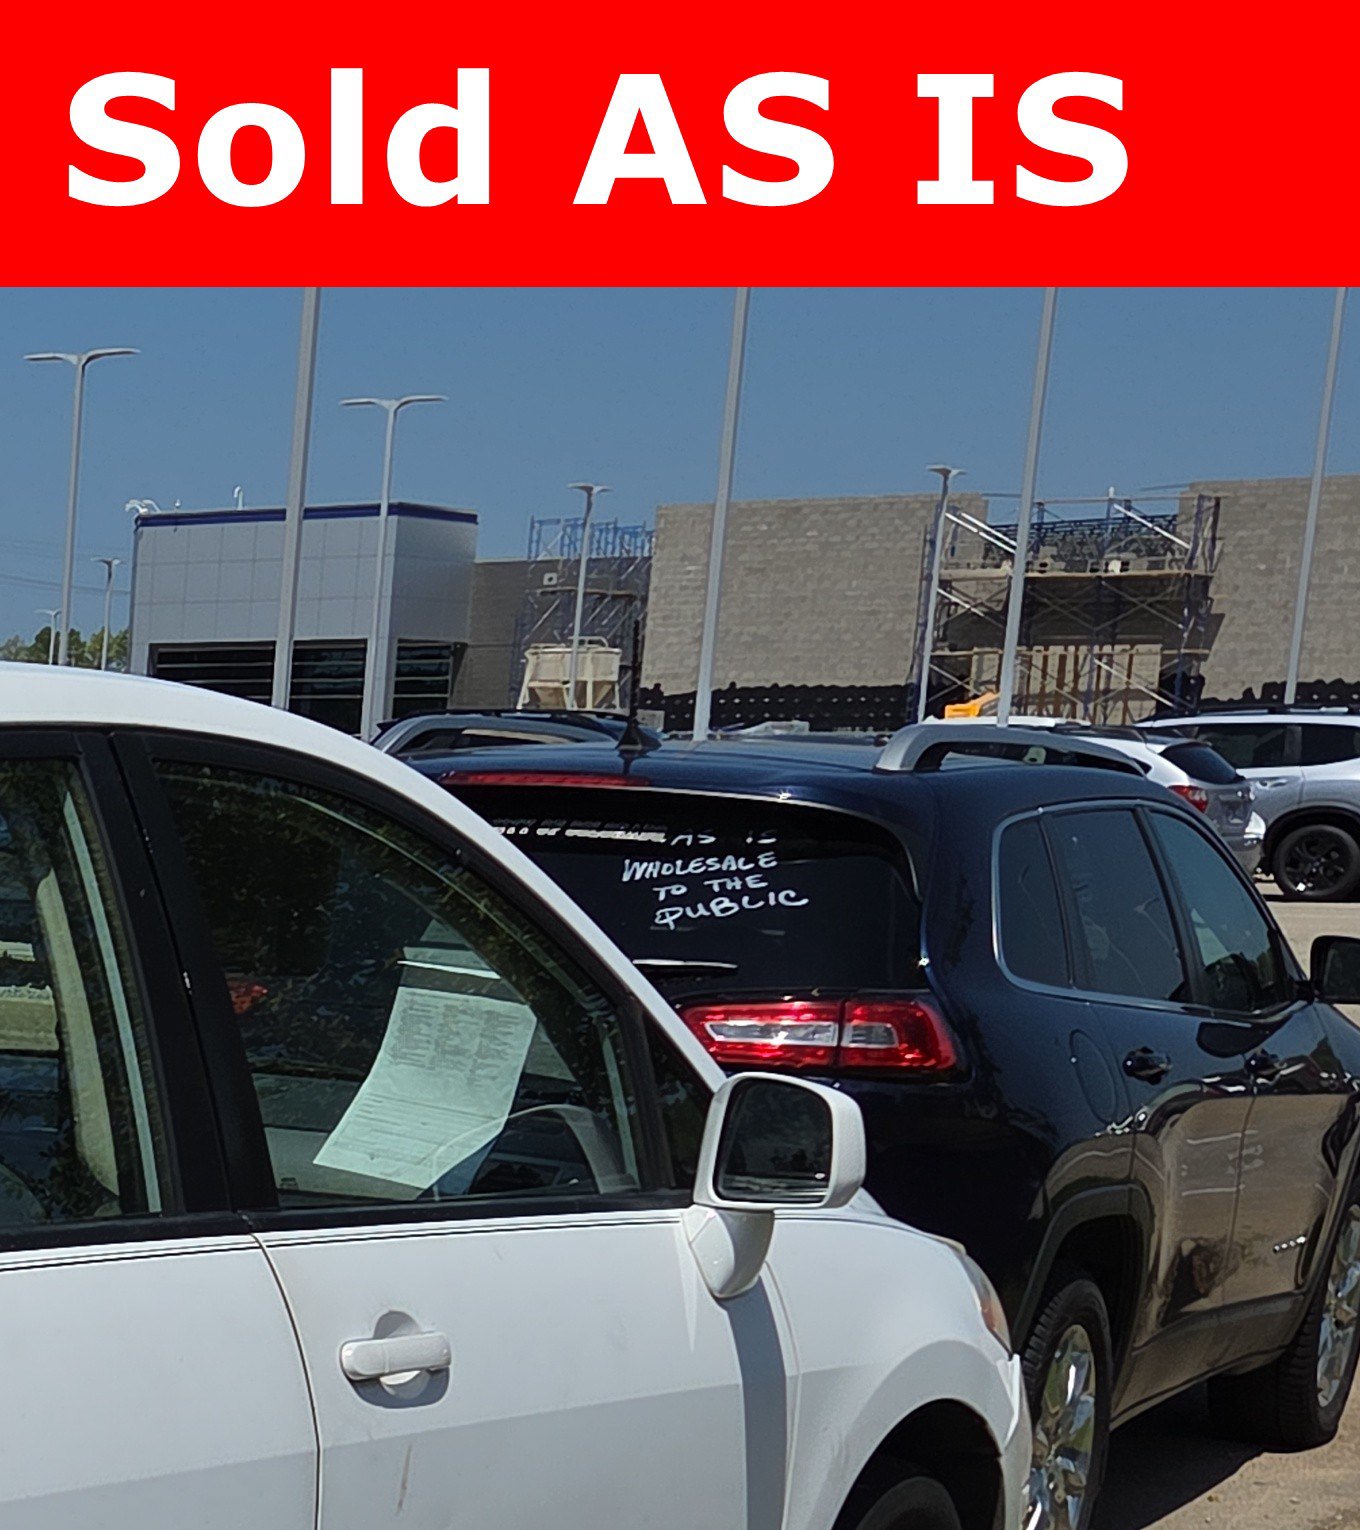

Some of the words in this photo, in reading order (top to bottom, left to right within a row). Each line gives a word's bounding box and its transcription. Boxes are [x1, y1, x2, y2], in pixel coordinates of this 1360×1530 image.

[621, 851, 778, 882] WHOLESALE
[653, 884, 688, 901] TO
[703, 874, 769, 892] THE
[654, 889, 810, 930] PUBLIC
